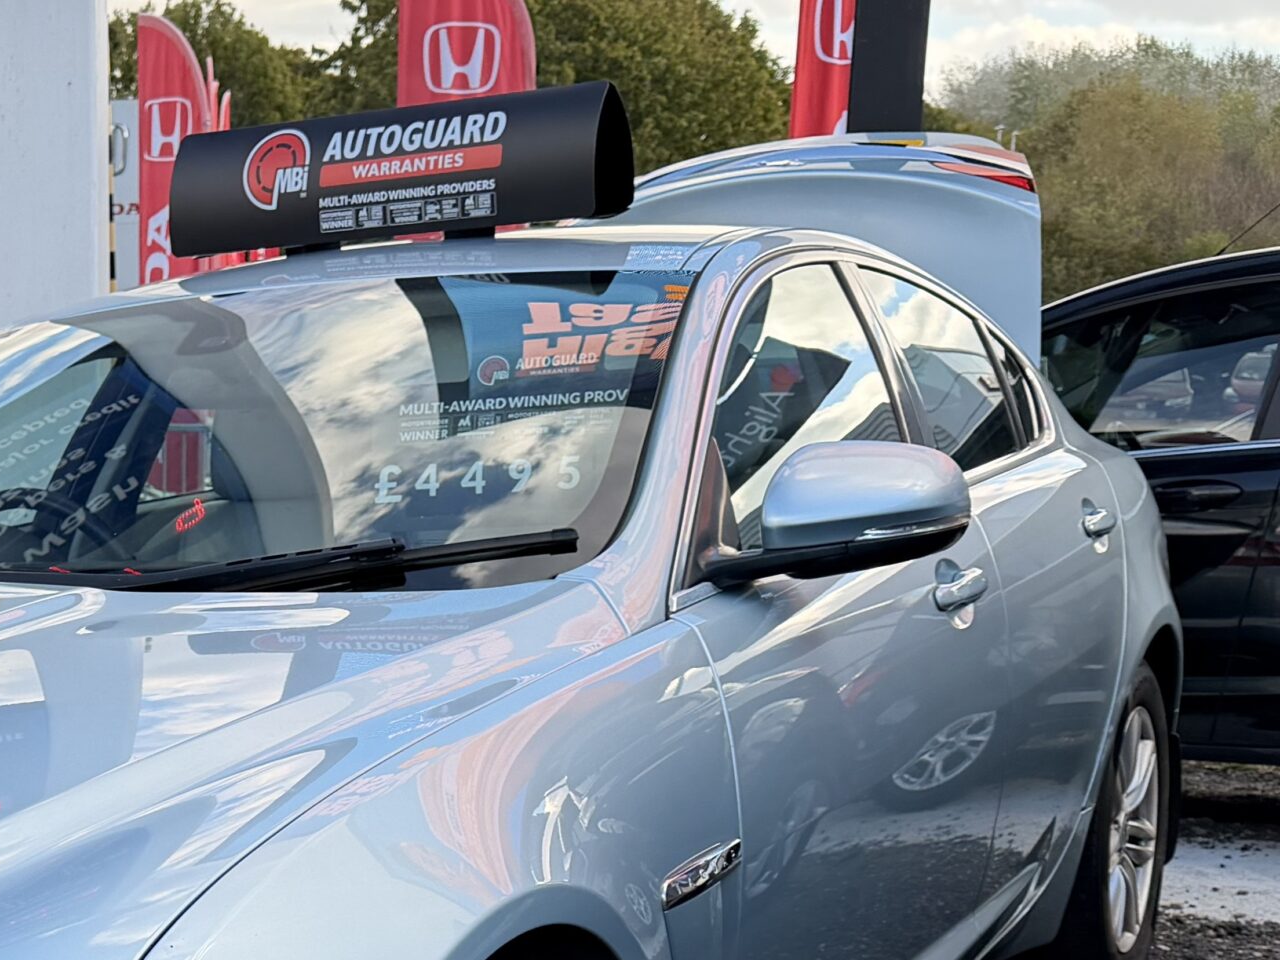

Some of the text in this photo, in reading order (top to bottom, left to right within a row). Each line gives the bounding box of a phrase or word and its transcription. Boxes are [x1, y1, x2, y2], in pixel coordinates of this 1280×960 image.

[322, 110, 508, 162] AUTOGUARD
[352, 152, 464, 179] WARRANTIES
[319, 178, 496, 208] MULTI-AWARD WINNING PROVIDERS
[321, 219, 354, 230] WINNER
[515, 352, 596, 370] AUTOGUARD
[529, 367, 580, 376] WARRANTIES
[399, 397, 507, 418] MULTI-AWARD
[508, 391, 581, 409] WINNING
[399, 429, 449, 442] WINNER
